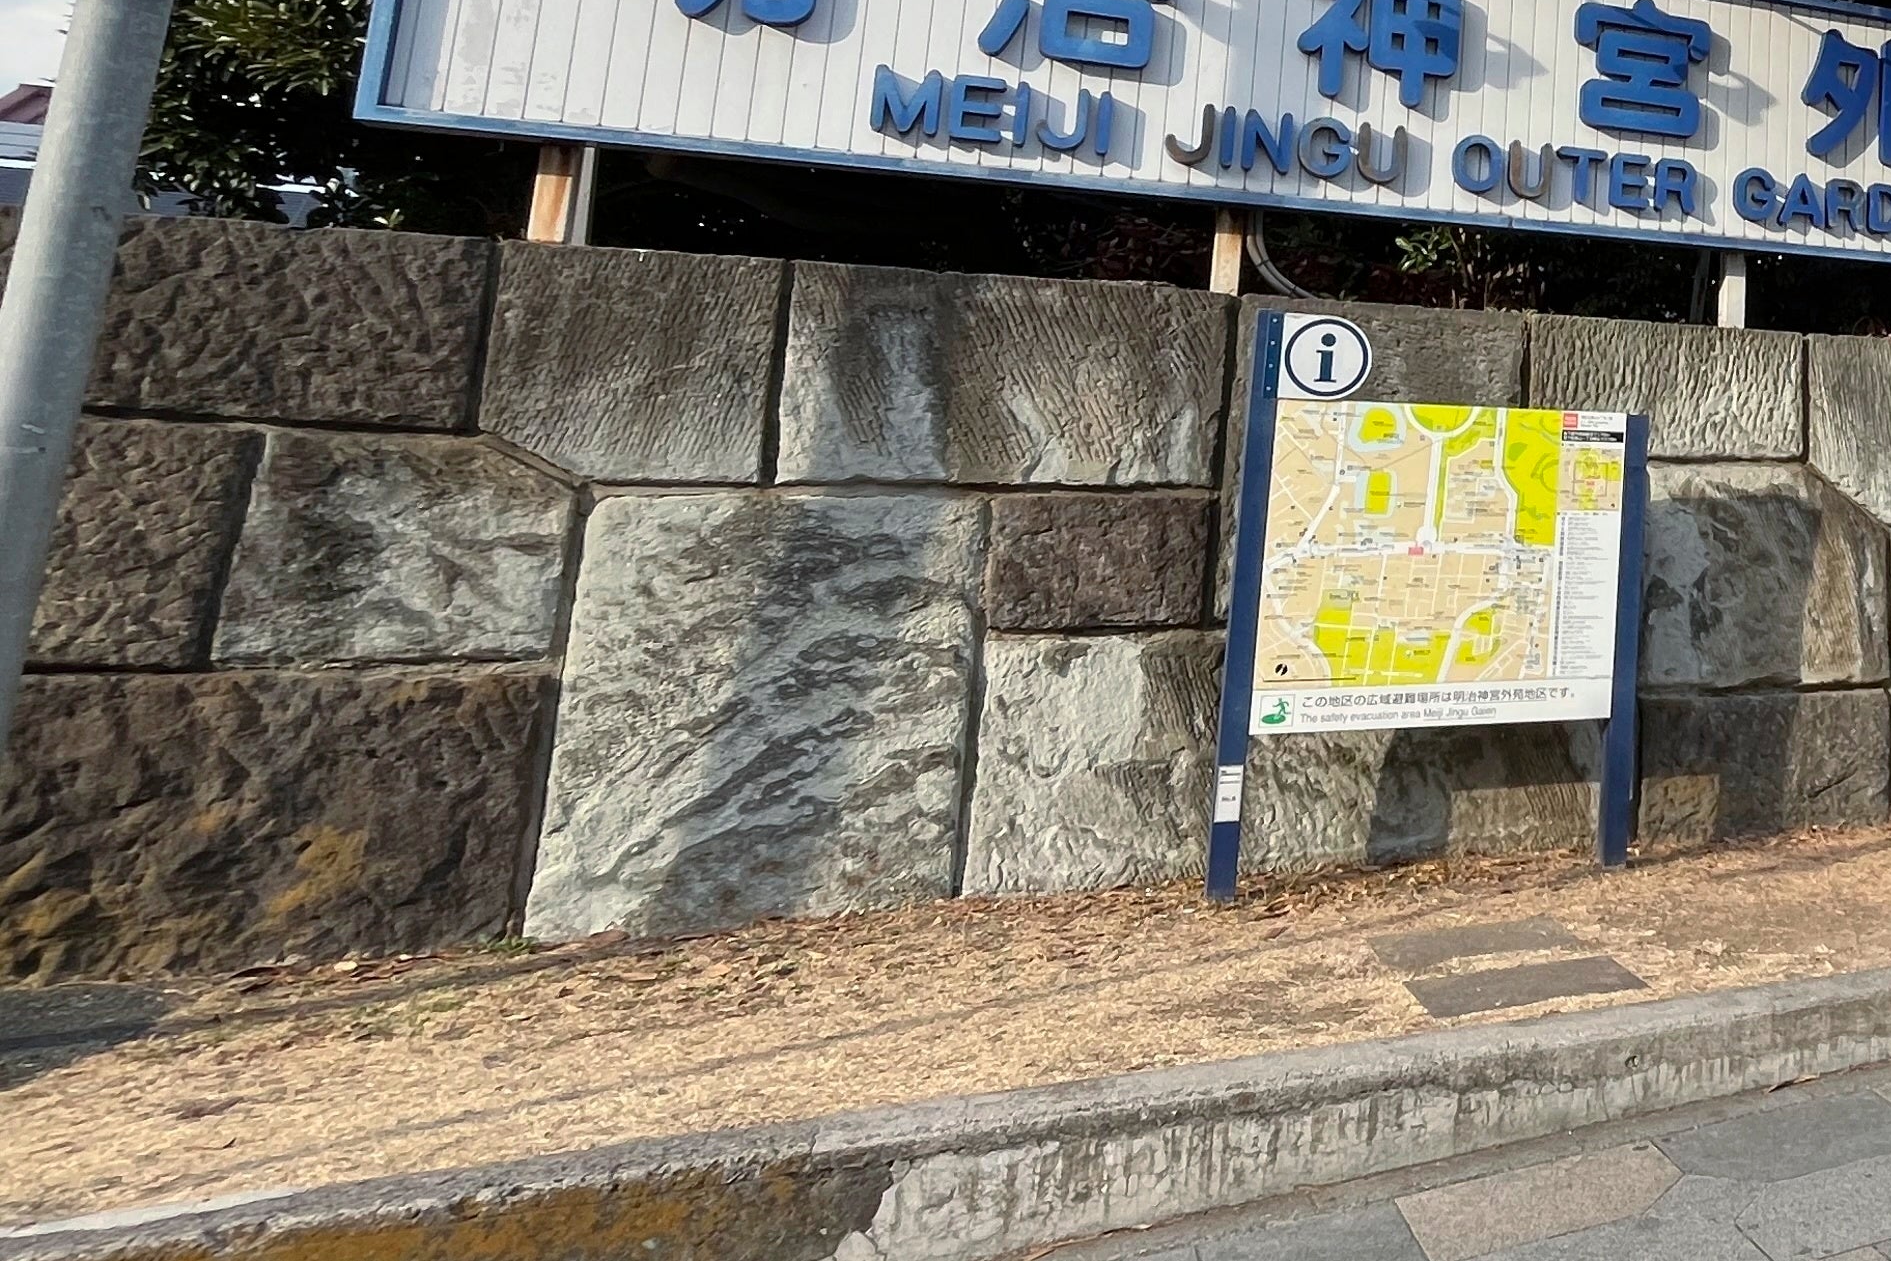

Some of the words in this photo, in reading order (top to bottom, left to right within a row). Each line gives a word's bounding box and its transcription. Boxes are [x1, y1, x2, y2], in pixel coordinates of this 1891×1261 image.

[870, 65, 1112, 156] MEIJI
[1165, 102, 1407, 185] JINGU
[1451, 133, 1699, 215] OUTER
[1300, 713, 1318, 723] The
[1320, 712, 1348, 724] safety
[1350, 710, 1399, 721] evacuation
[1401, 710, 1421, 719] area
[1446, 707, 1469, 719] Jingu
